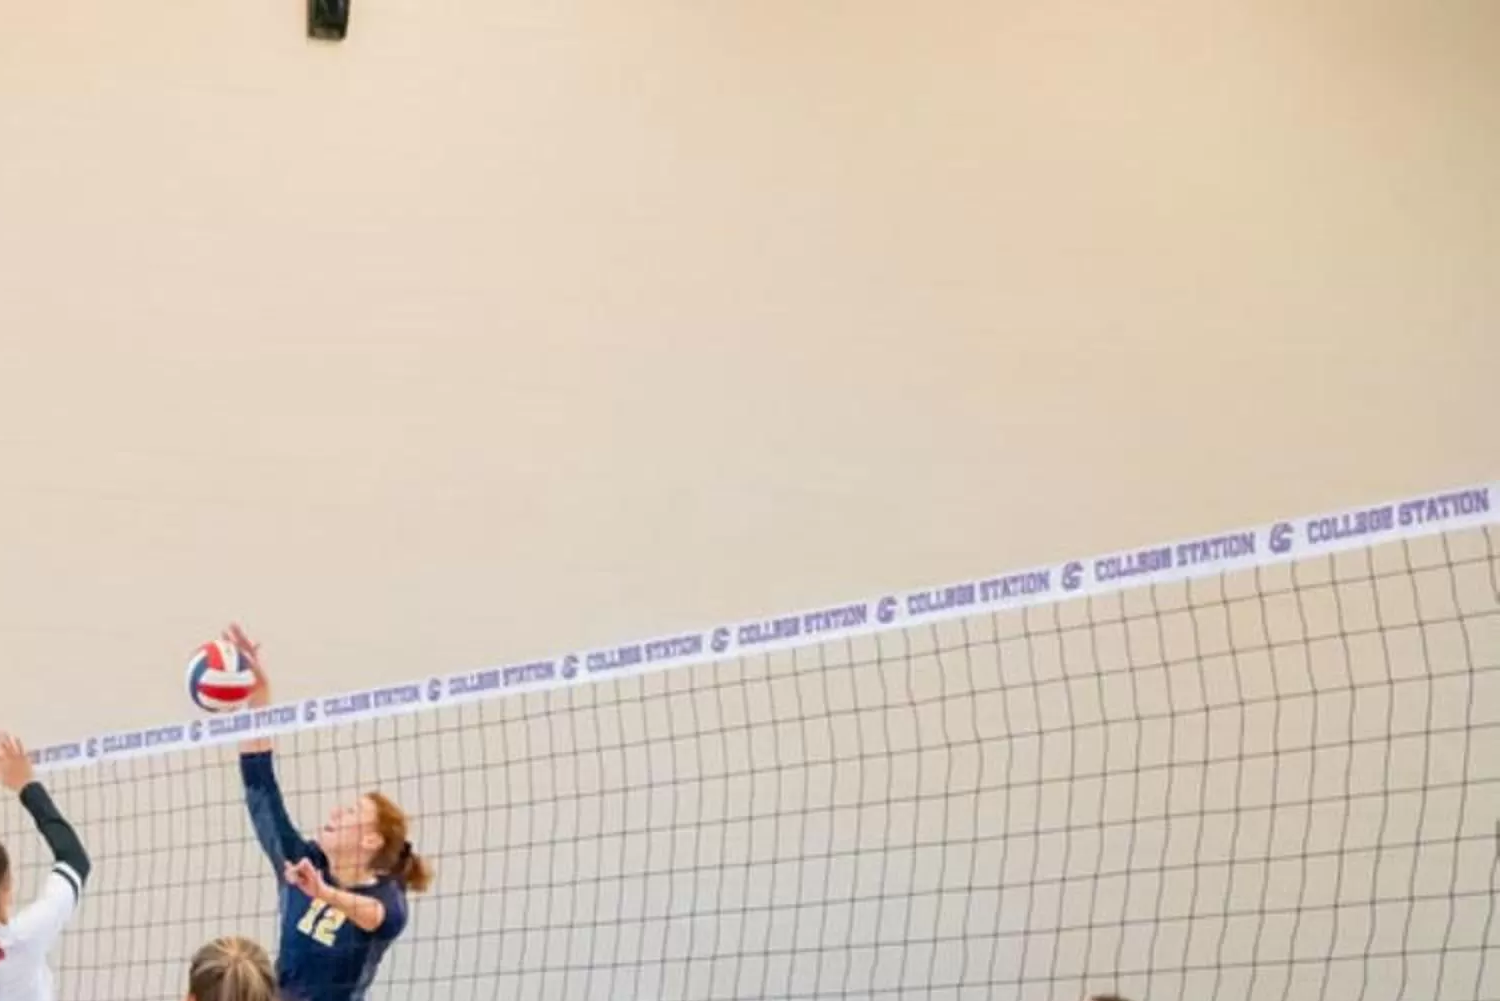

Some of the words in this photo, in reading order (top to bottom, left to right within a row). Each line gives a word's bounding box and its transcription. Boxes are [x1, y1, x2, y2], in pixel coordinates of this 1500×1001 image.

[1307, 505, 1393, 544] COLLEGE
[1398, 488, 1489, 526] STATION
[1094, 547, 1171, 581] COLLEGE
[1176, 532, 1255, 566] STATION
[979, 571, 1050, 602] STATION
[804, 604, 867, 633] STATION
[297, 899, 346, 947] 12
